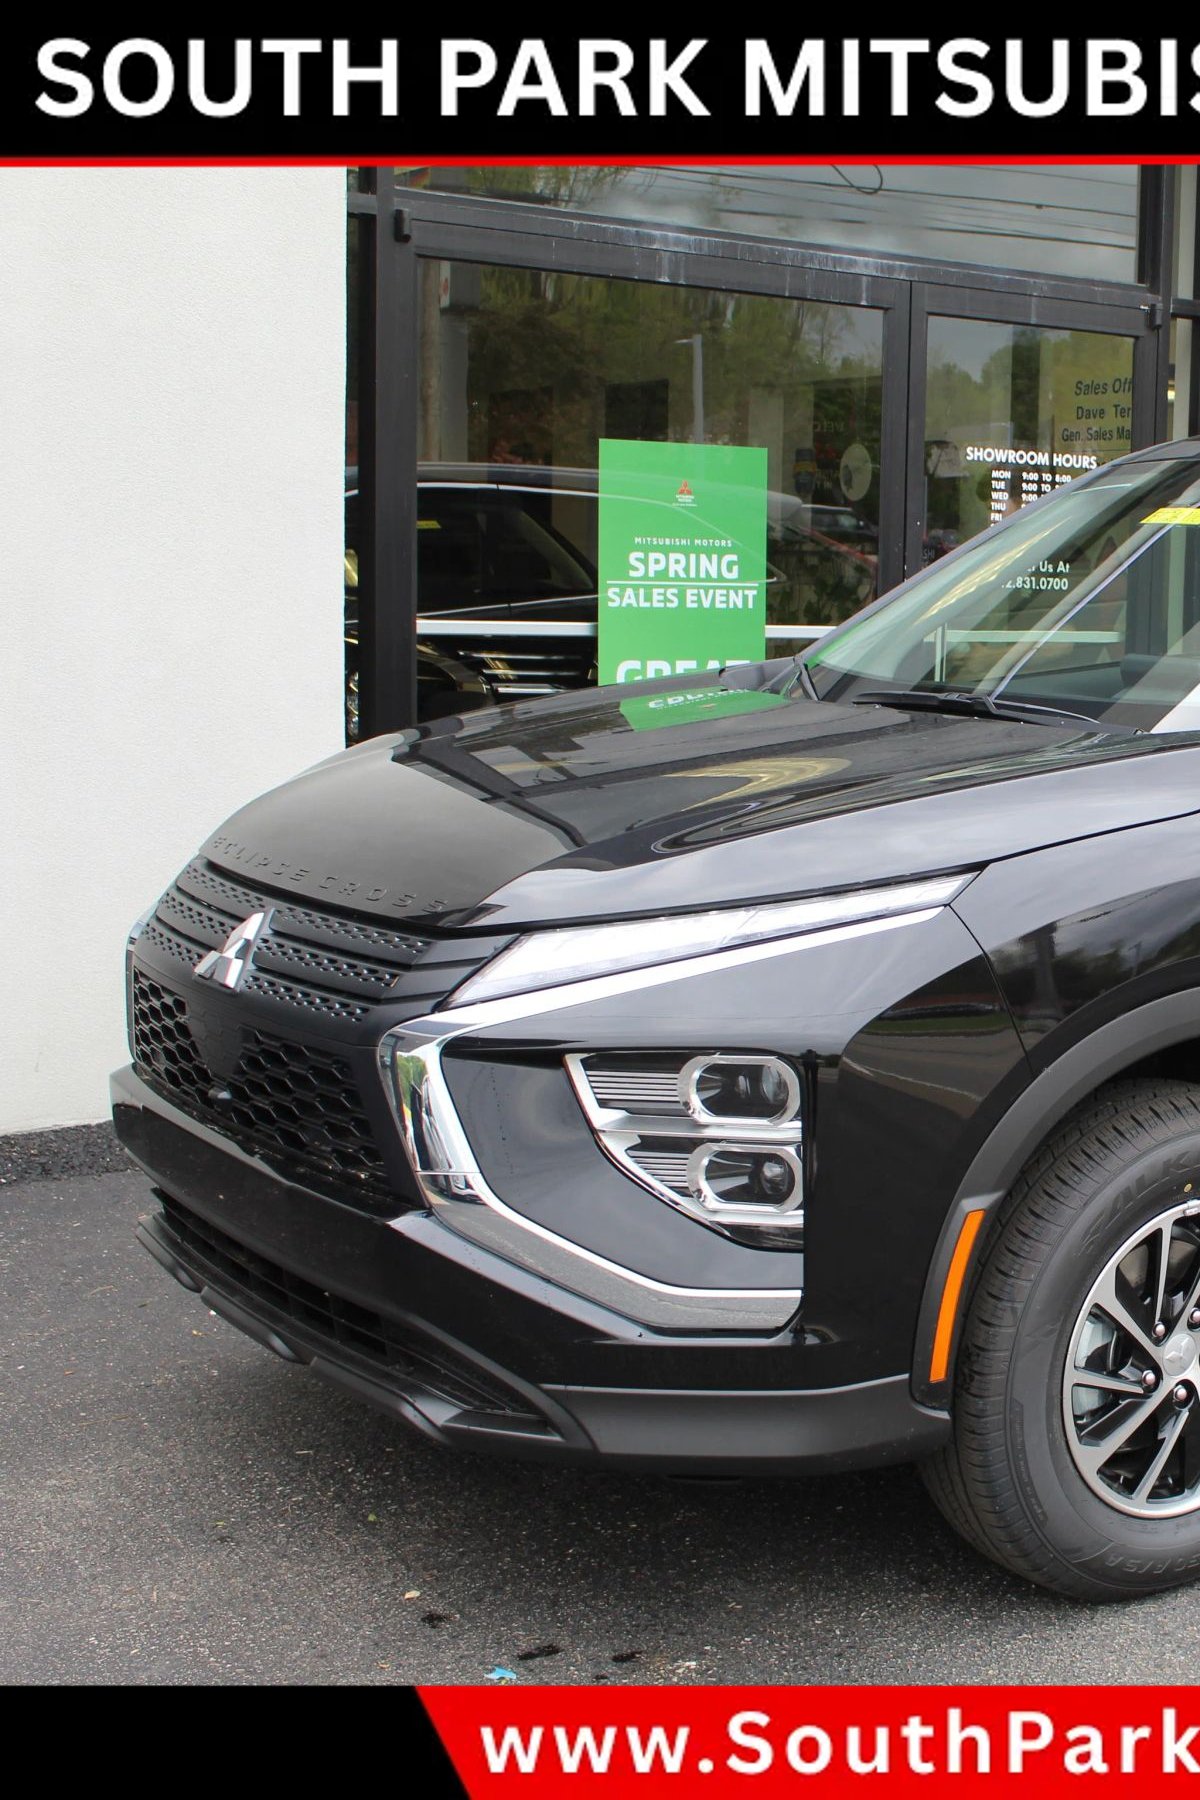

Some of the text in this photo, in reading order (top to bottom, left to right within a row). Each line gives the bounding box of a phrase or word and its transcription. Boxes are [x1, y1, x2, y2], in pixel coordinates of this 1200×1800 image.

[1074, 380, 1108, 396] Sales
[1076, 406, 1105, 420] Dave
[1062, 428, 1084, 442] Gen.
[1087, 427, 1113, 441] Sales
[966, 446, 1050, 467] SHOWROOM
[1053, 453, 1098, 470] HOURS
[991, 470, 1072, 483] MON 9:00 TO 8:00
[991, 481, 1006, 489] TUE
[1022, 482, 1038, 491] 9:00
[1041, 483, 1051, 492] TO
[991, 491, 1009, 500] WED
[991, 502, 1006, 511] THU
[990, 513, 1002, 522] FRI
[634, 537, 732, 547] MITSUBISHI MOTORS
[628, 551, 739, 579] SPRING
[1039, 560, 1054, 573] Us
[1056, 560, 1070, 573] At
[607, 587, 757, 609] SALES EVENT
